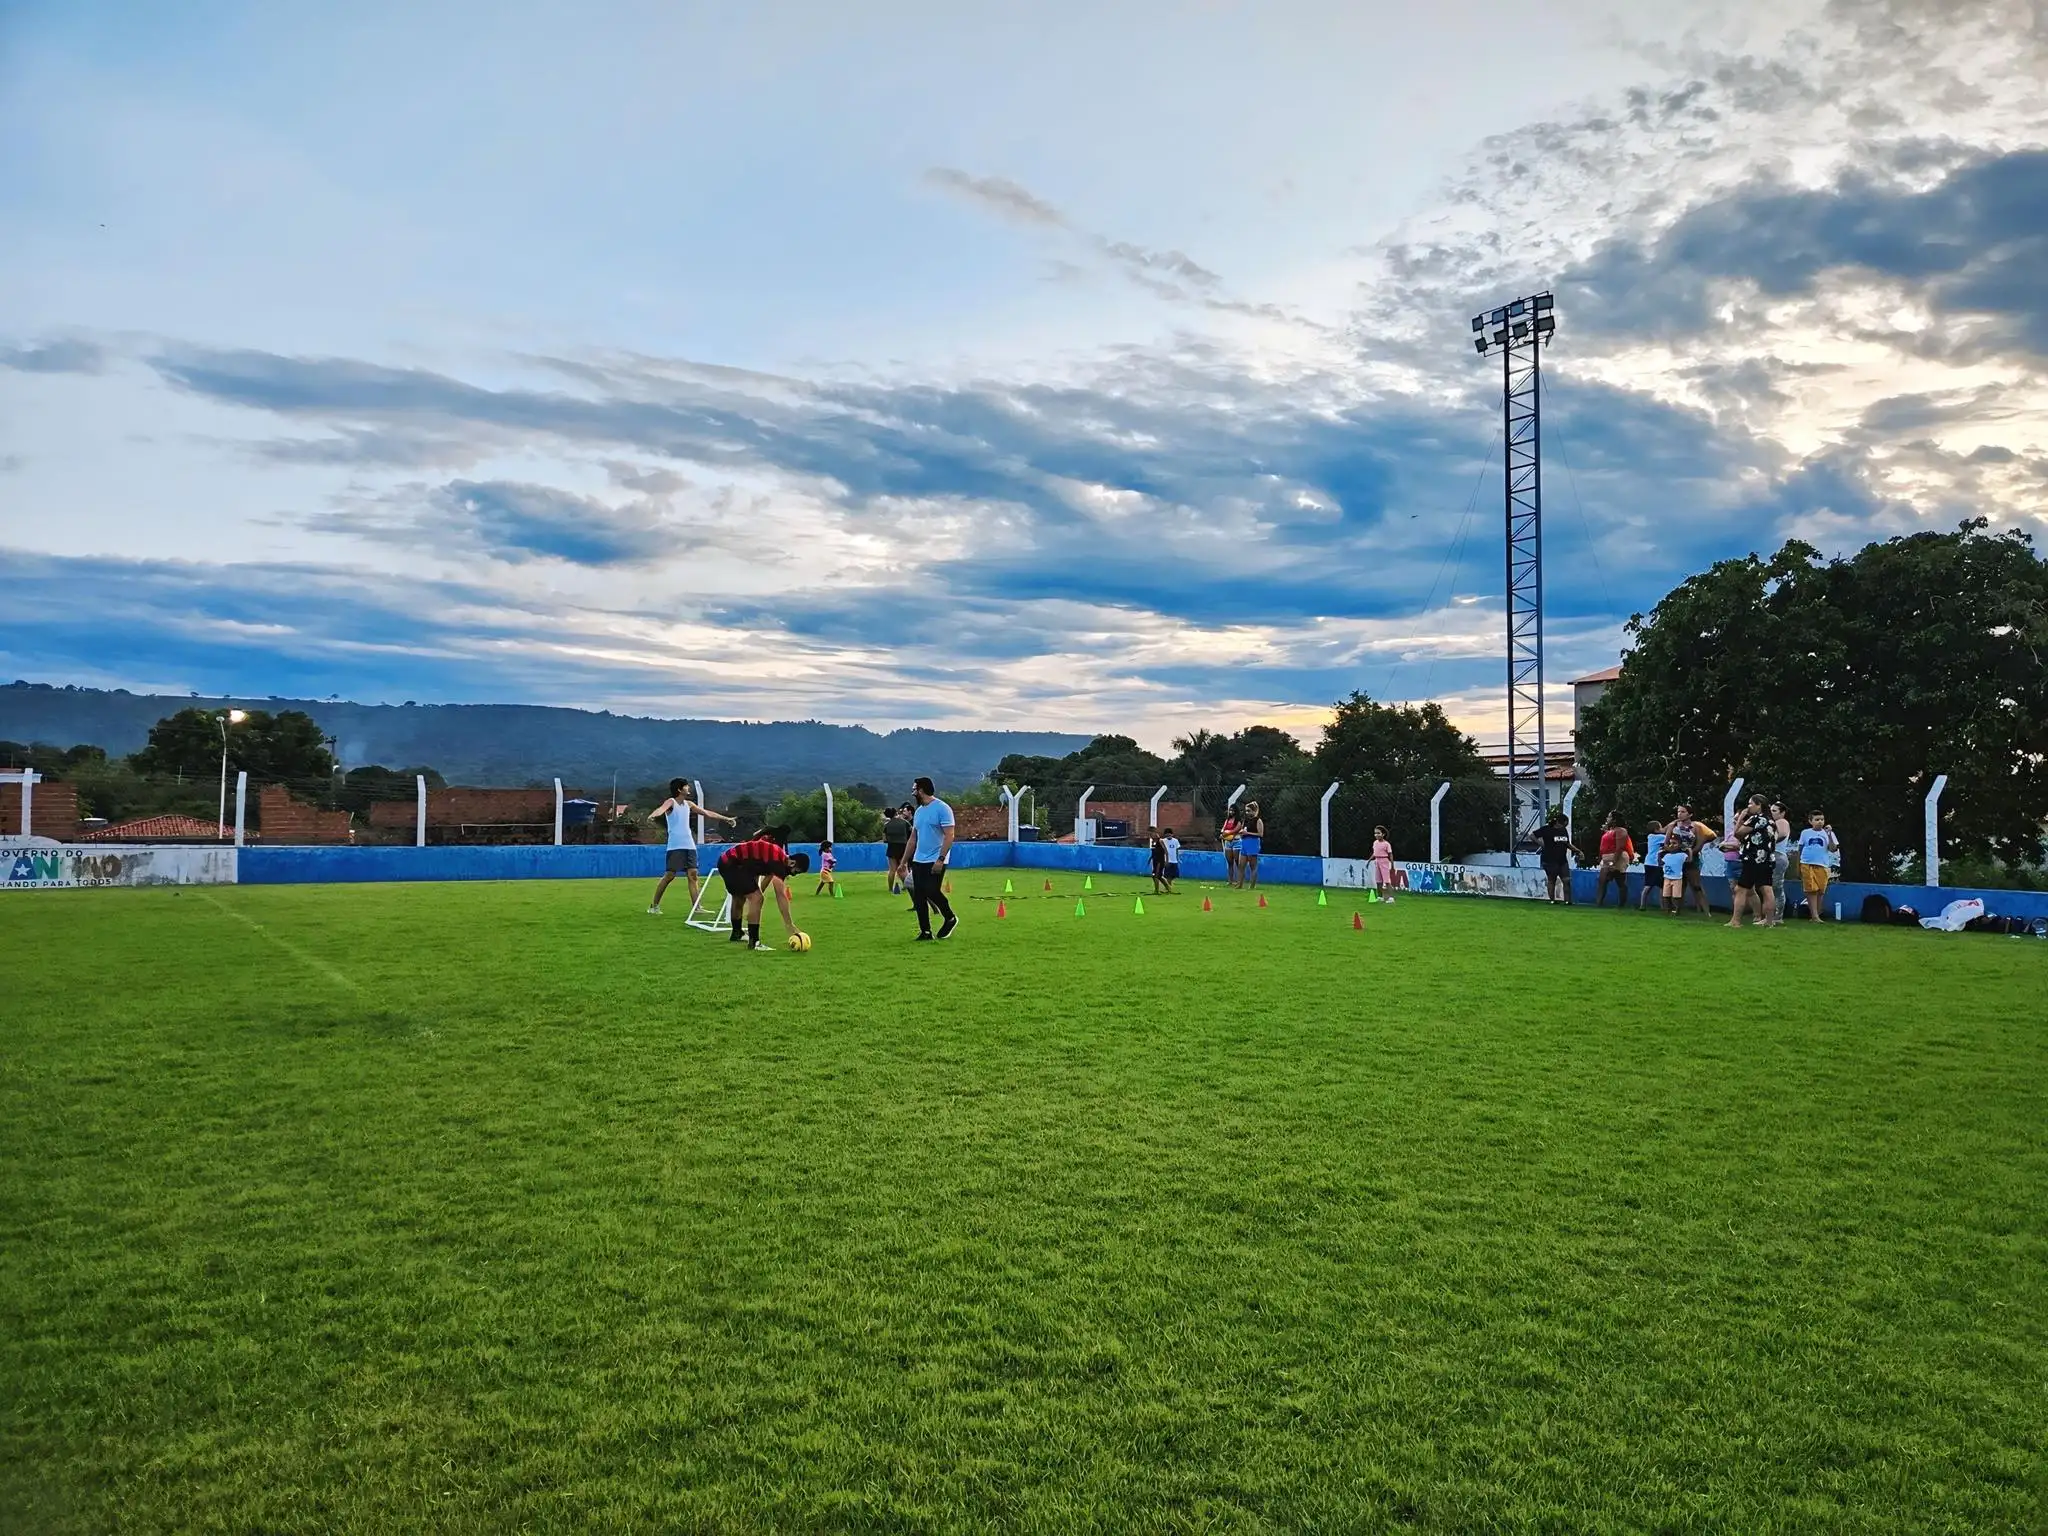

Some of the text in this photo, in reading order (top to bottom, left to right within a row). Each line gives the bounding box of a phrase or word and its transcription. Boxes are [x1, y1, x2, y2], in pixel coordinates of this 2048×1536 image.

[66, 850, 84, 858] DO
[1405, 862, 1466, 874] GOVERNO DO
[76, 878, 112, 887] TODOS
